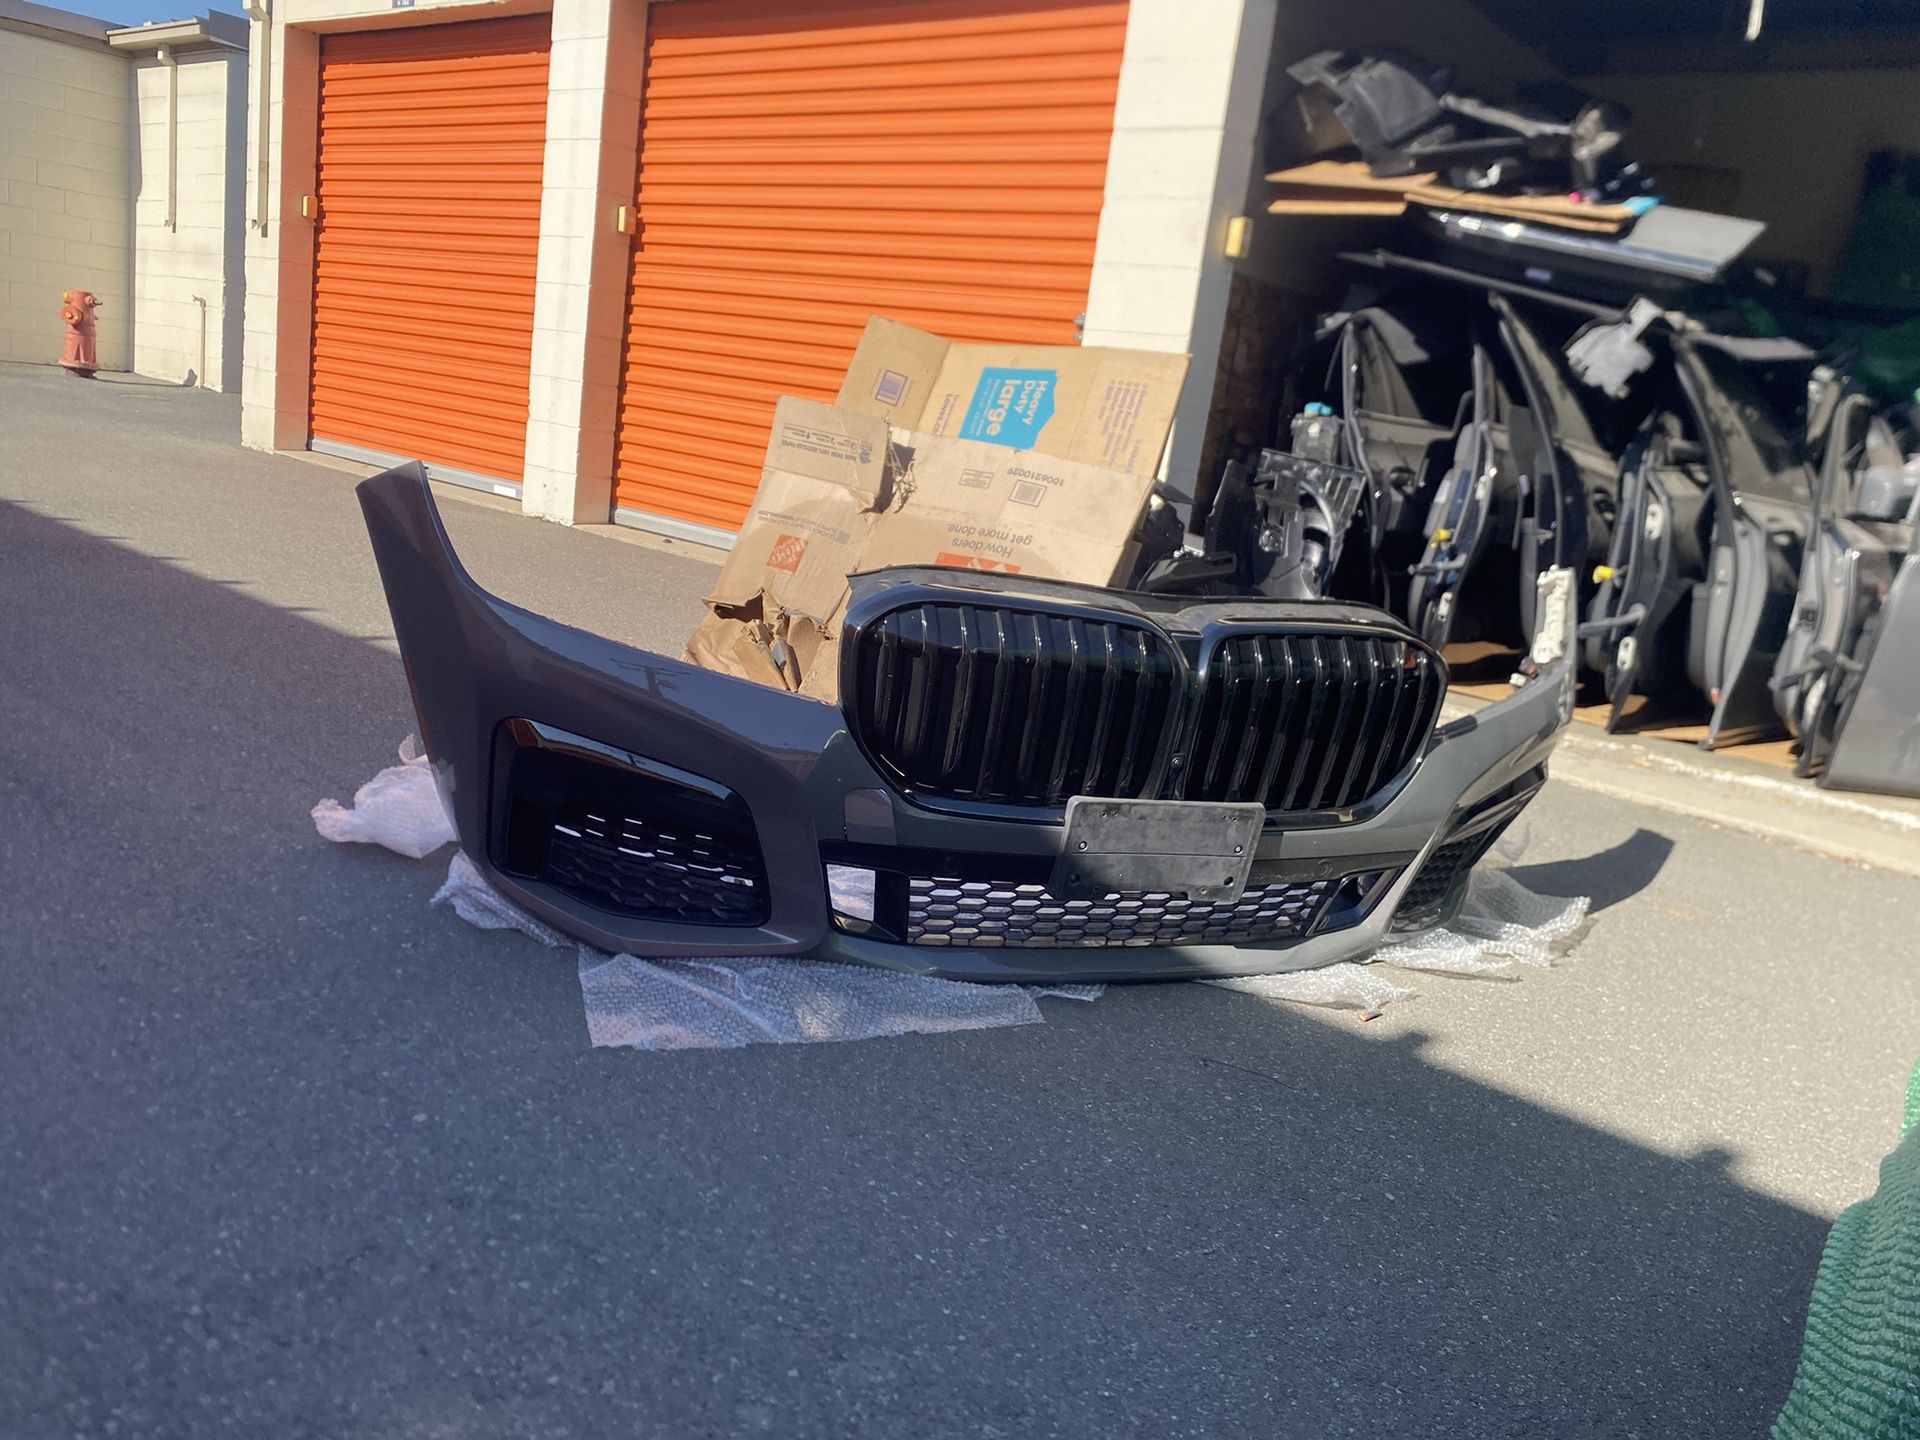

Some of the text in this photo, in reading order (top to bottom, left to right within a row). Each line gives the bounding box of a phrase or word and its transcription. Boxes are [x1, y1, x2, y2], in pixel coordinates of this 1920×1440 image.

[1013, 380, 1035, 413] Duty
[1022, 380, 1048, 425] Heavy
[986, 379, 1021, 436] large
[1006, 467, 1065, 486] 1006210029
[978, 525, 1009, 541] more
[1009, 533, 1033, 545] get
[951, 537, 1014, 558] How doers
